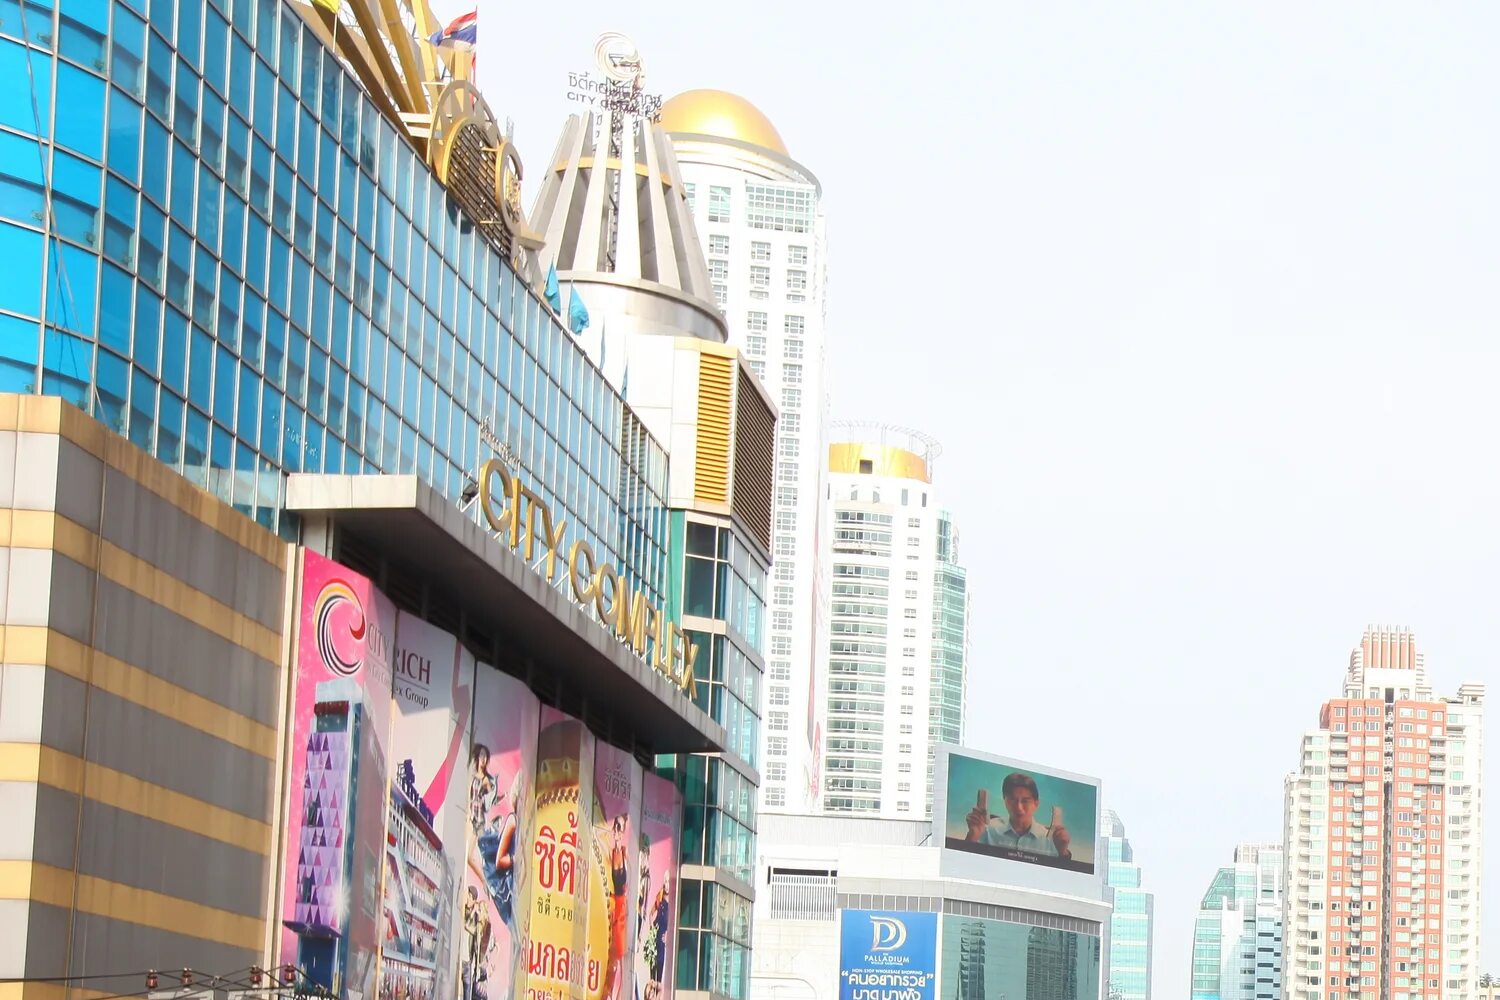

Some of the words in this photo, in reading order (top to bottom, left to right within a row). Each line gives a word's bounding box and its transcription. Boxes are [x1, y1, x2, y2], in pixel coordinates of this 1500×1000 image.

[567, 91, 596, 105] CITY
[481, 458, 567, 580] CITY
[570, 539, 699, 699] COMPLEX
[405, 687, 429, 709] Group
[864, 954, 910, 964] PALLADIUM
